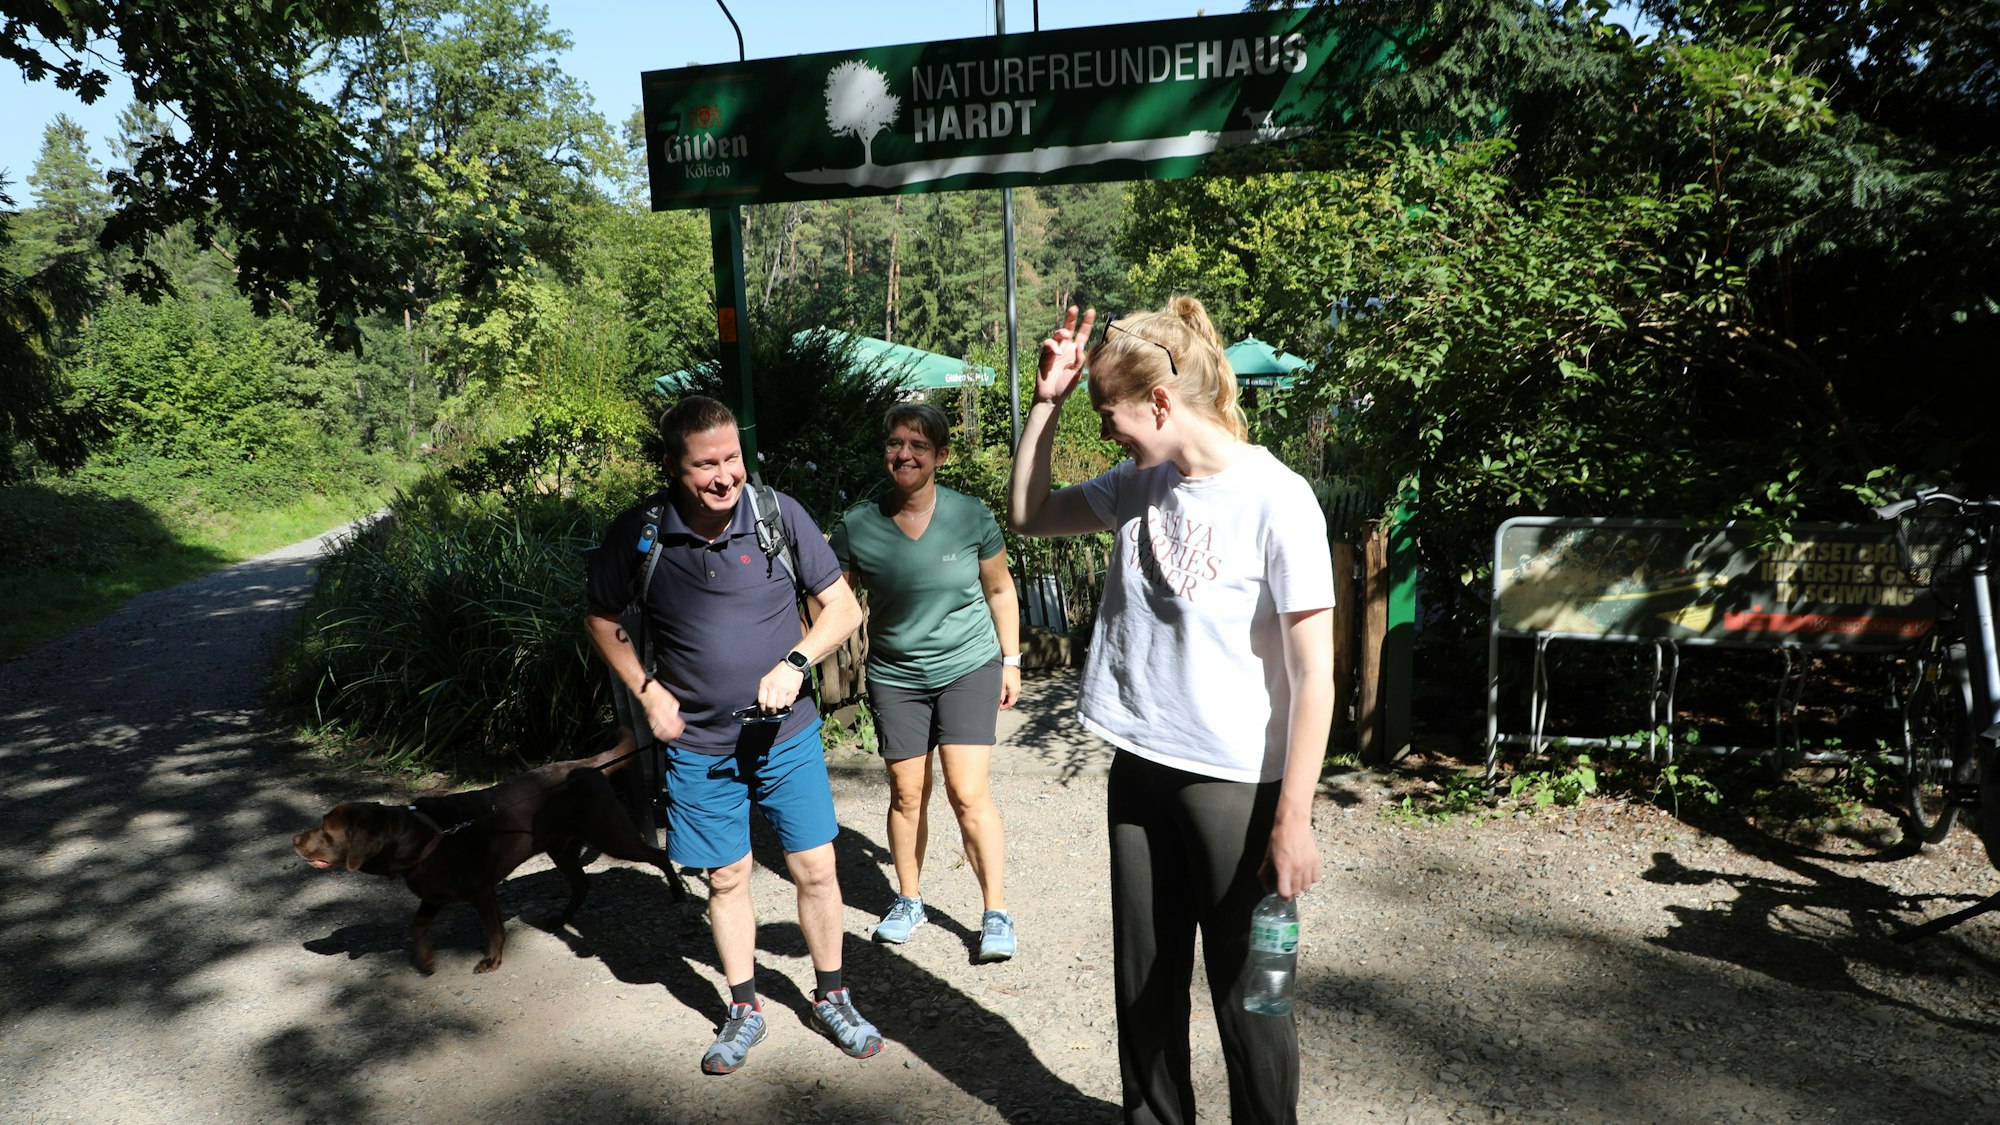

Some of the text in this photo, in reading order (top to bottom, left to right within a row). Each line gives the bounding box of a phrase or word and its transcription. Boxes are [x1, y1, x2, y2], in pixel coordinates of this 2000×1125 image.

[912, 32, 1308, 101] NATURFREUNDEHAUS
[914, 99, 1037, 143] HARDT
[664, 132, 749, 163] Gilden
[685, 162, 731, 179] Kölsch
[1130, 520, 1221, 581] CARRIES
[1128, 545, 1195, 603] WATER
[1761, 562, 1798, 582] IHR
[1802, 563, 1875, 584] ERSTES
[1777, 583, 1916, 606] IN SCHWUNG
